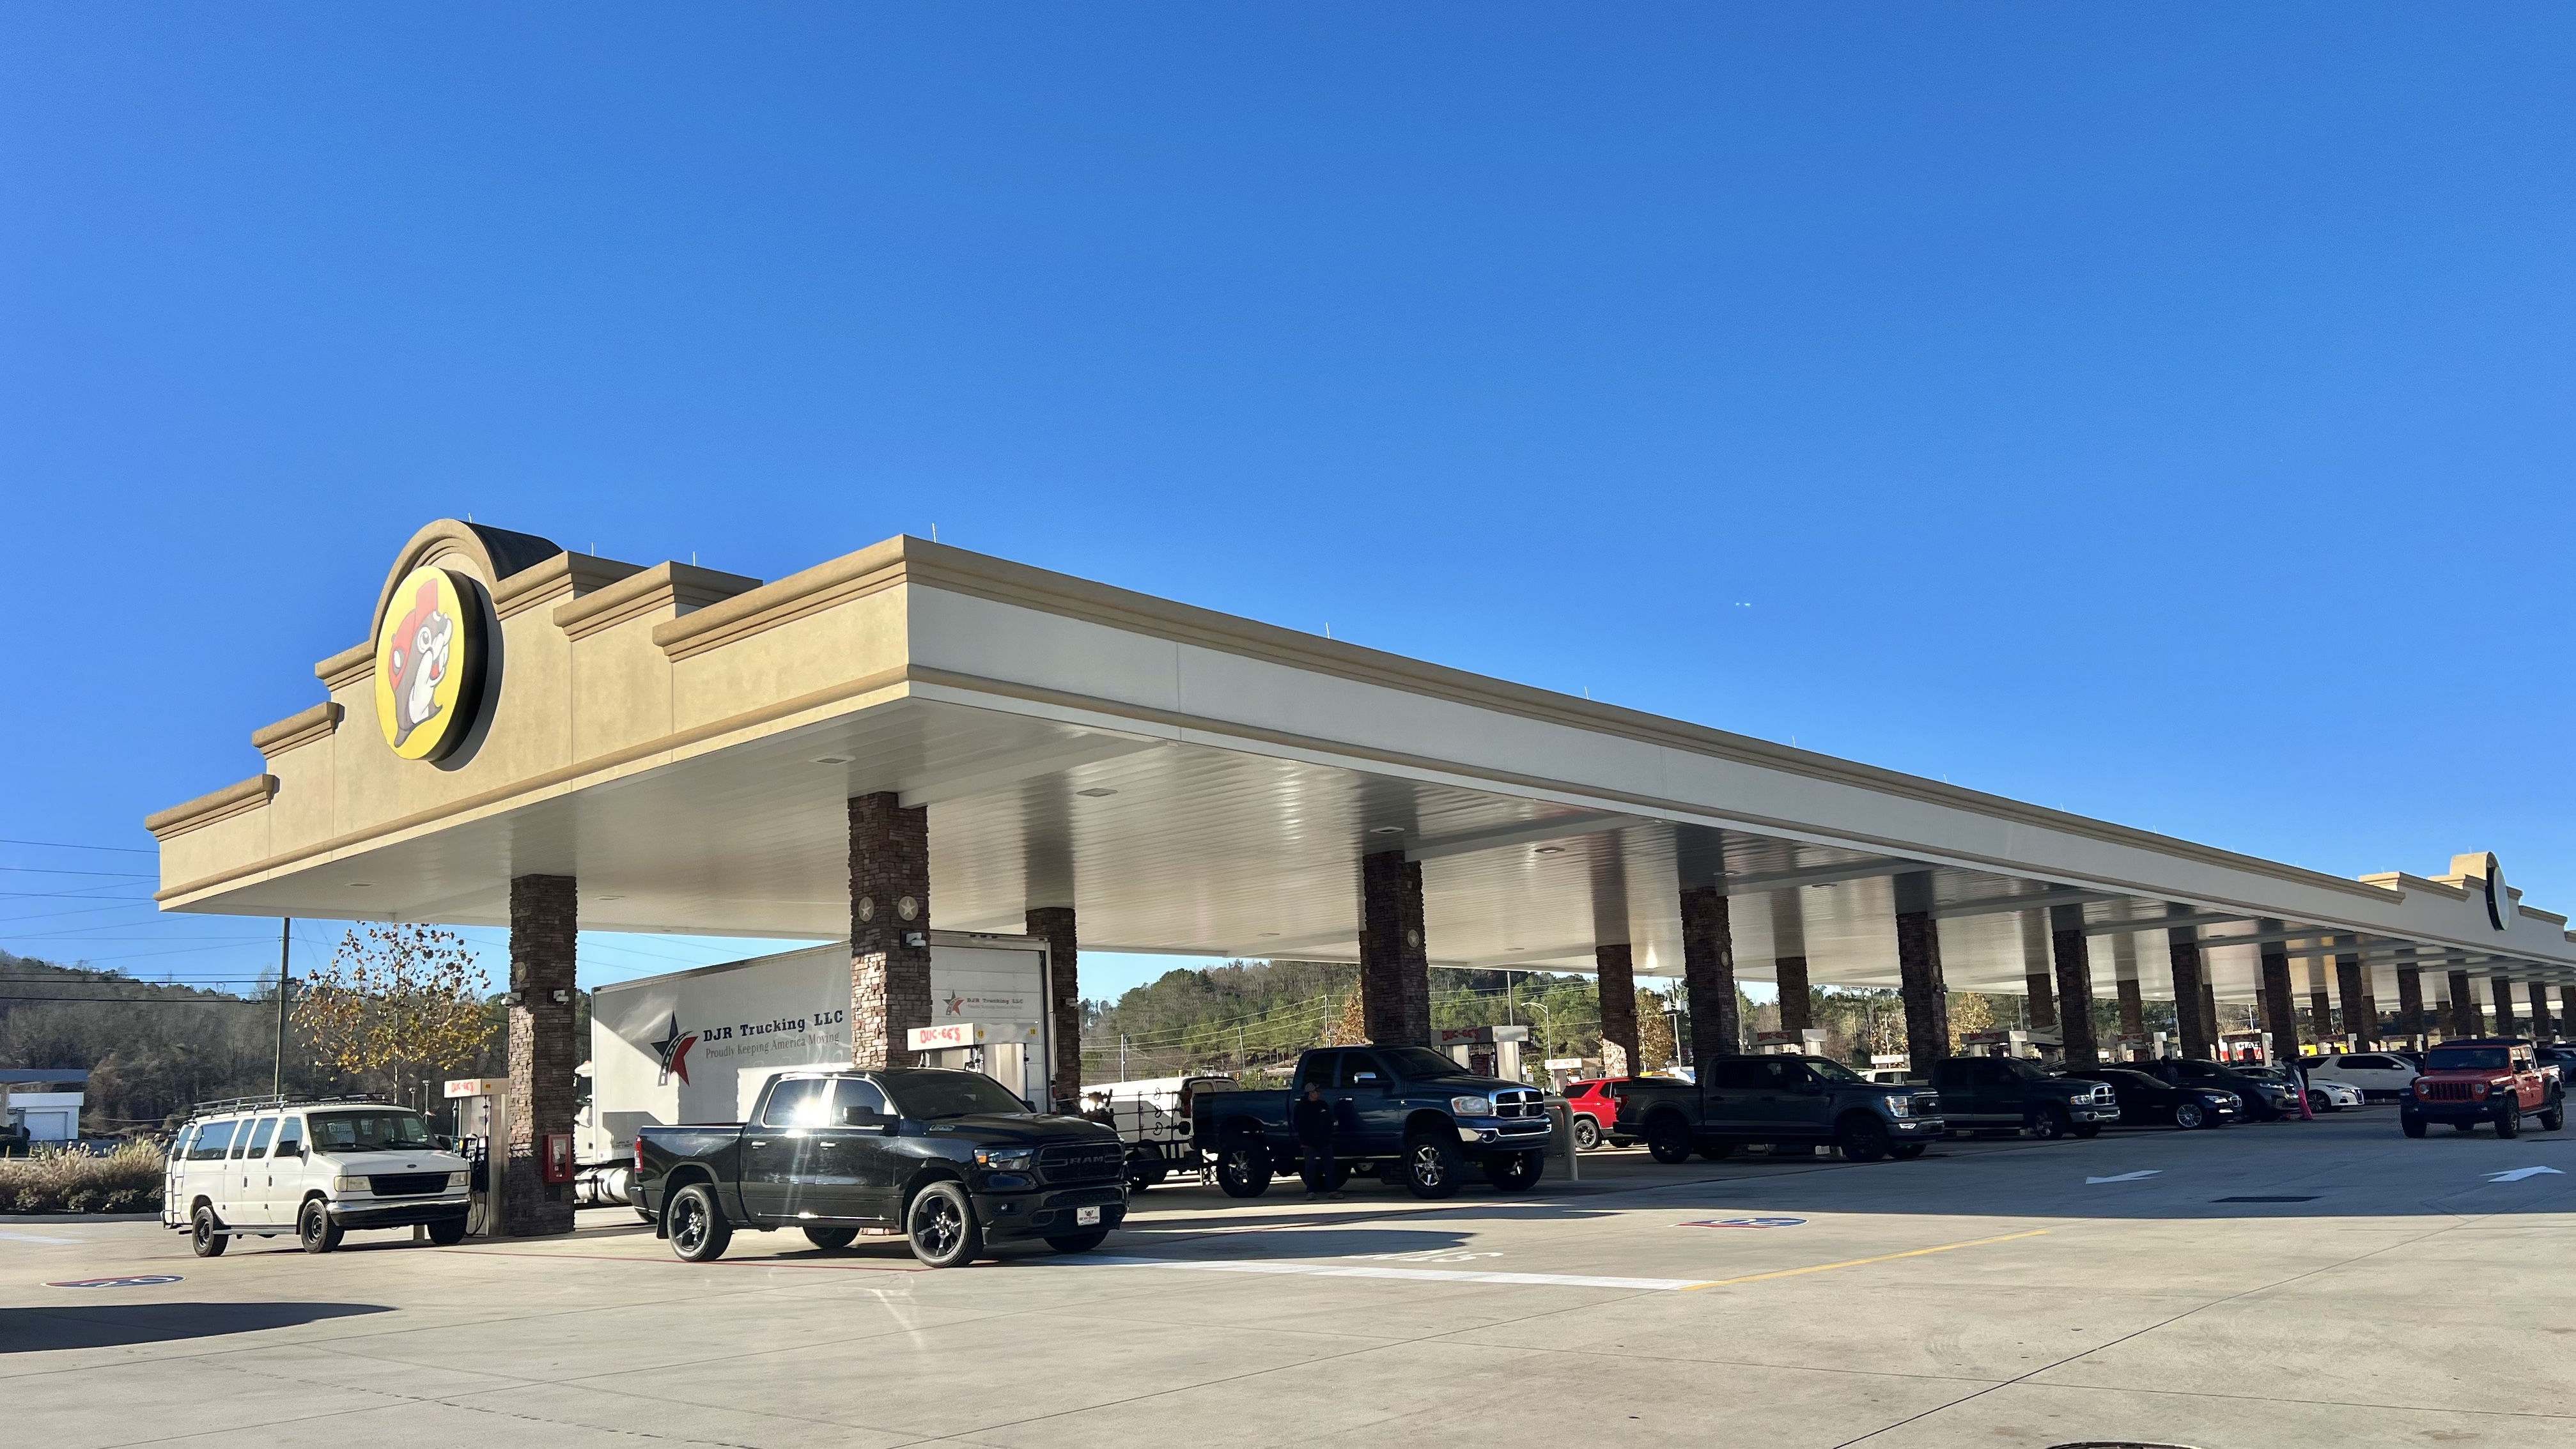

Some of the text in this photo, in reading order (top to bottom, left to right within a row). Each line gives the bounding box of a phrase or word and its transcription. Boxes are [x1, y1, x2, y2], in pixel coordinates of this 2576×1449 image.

[703, 1010, 843, 1042] DJR Trucking LLC
[706, 1032, 839, 1059] Proudly Keeping America Moving
[1069, 1156, 1104, 1164] RAM
